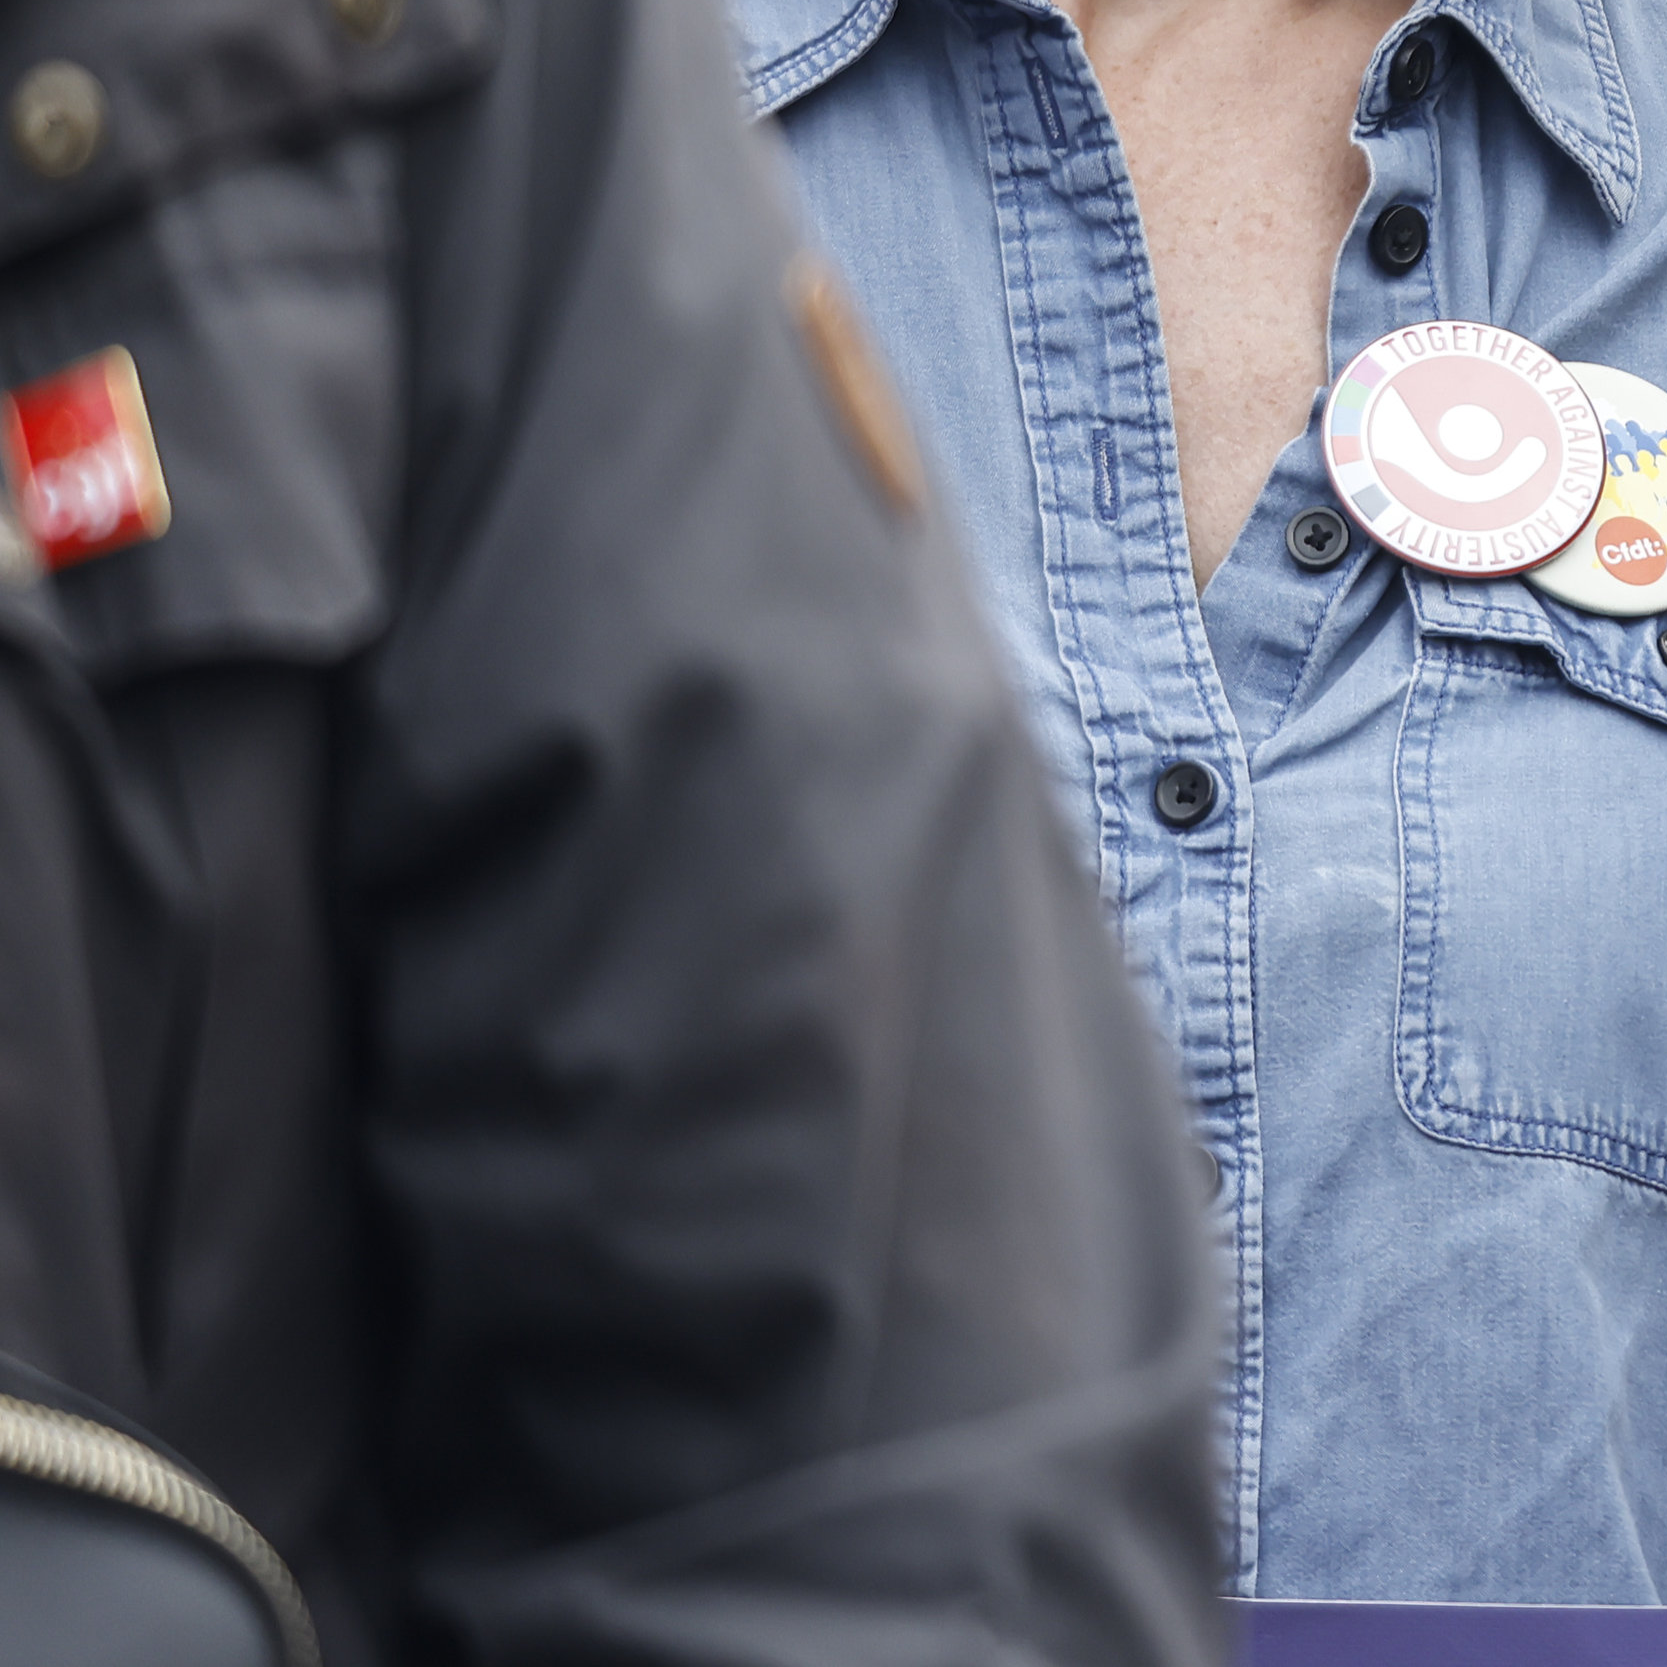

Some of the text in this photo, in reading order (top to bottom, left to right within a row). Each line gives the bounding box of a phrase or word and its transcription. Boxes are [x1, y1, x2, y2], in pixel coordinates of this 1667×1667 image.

[1381, 325, 1599, 566] TOGETHER AGAINST AUSTERITY
